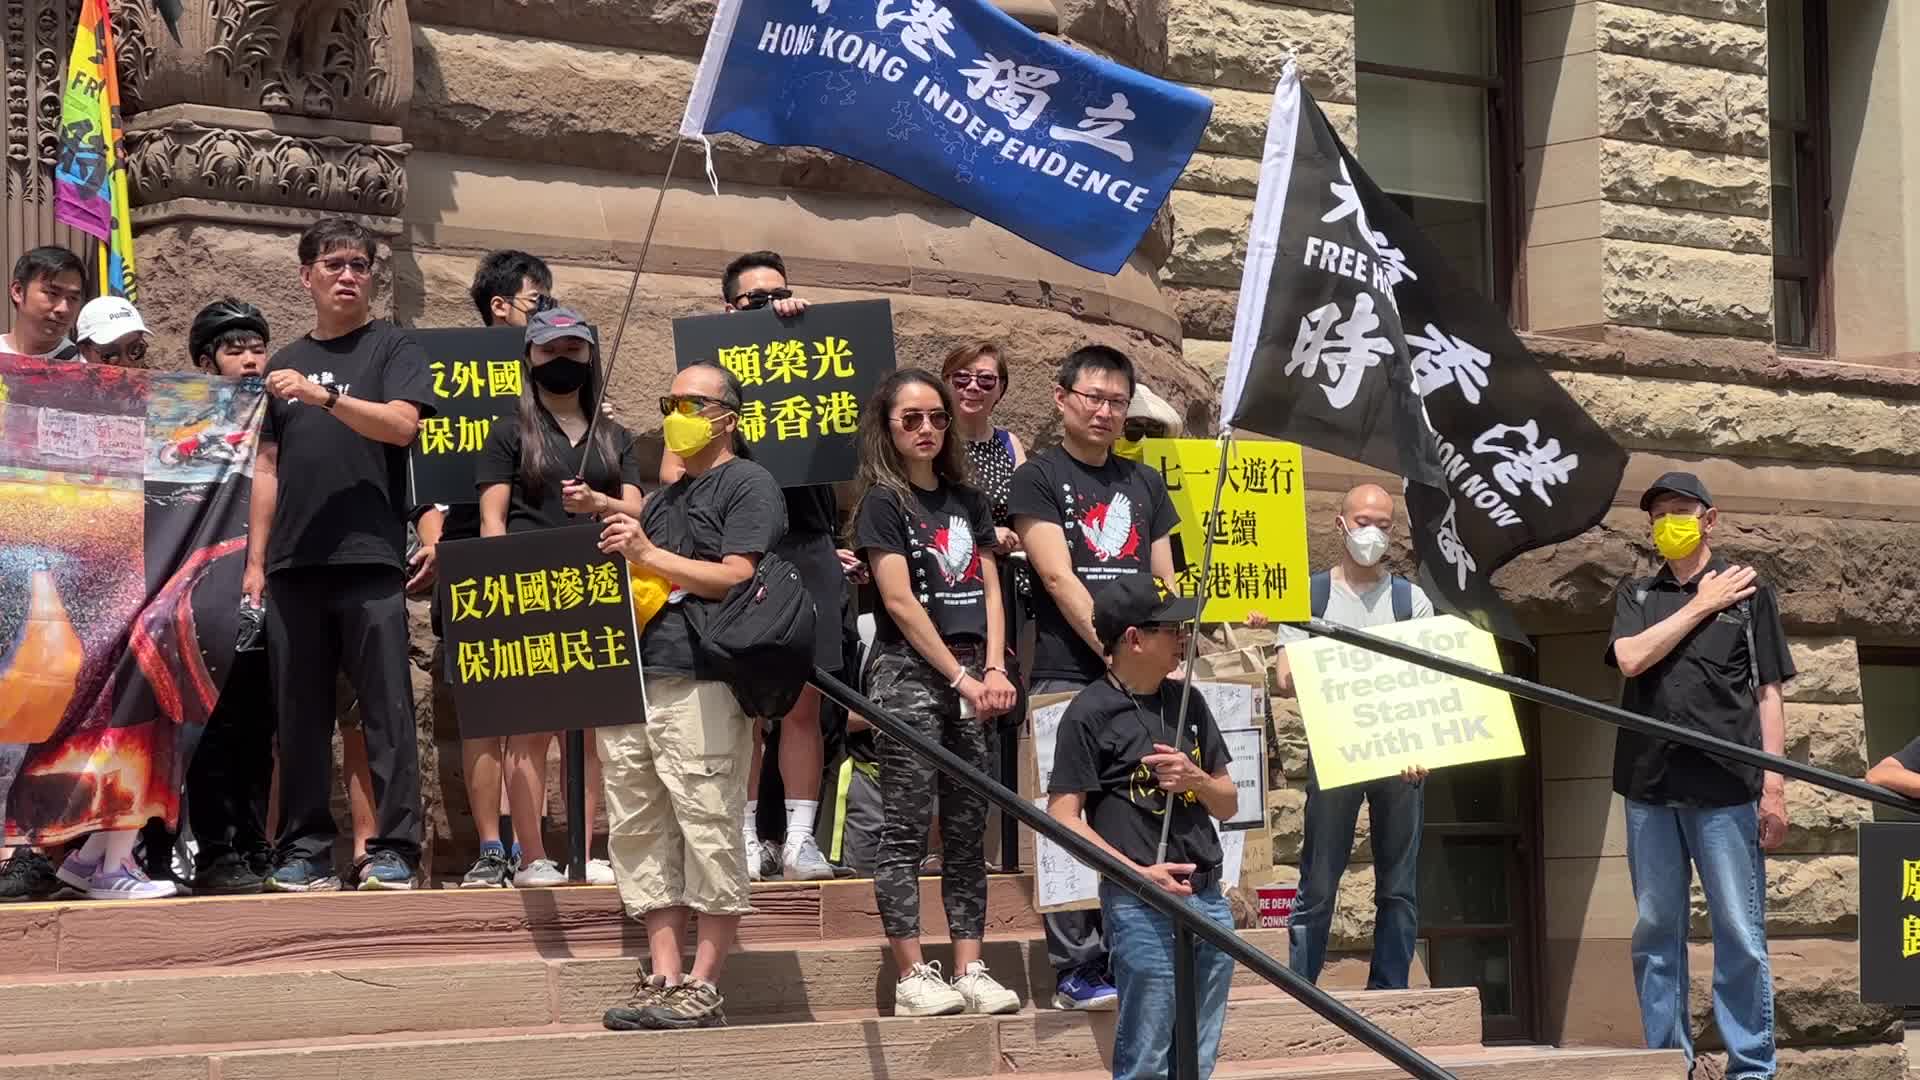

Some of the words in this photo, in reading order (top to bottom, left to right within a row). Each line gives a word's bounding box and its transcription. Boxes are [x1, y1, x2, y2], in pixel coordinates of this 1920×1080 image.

[811, 0, 1135, 163] 港獨立
[757, 20, 818, 55] HONG
[818, 26, 909, 83] KONG
[912, 75, 1150, 213] INDEPENDENCE
[1303, 236, 1369, 284] FREE
[418, 414, 500, 455] 保加
[1160, 455, 1295, 496] 七一大遊行
[1458, 474, 1523, 528] NOW
[1202, 509, 1259, 548] 延續
[450, 560, 623, 623] 反外國滲透
[1176, 562, 1288, 601] 香港精神
[457, 625, 632, 684] 保加國民主
[1312, 634, 1408, 673] Fig
[1420, 629, 1471, 654] for
[1320, 661, 1456, 705] freedo
[1352, 687, 1464, 729] Stand
[1338, 728, 1424, 764] with
[1431, 714, 1494, 748] HK
[1262, 915, 1289, 928] CONNE
